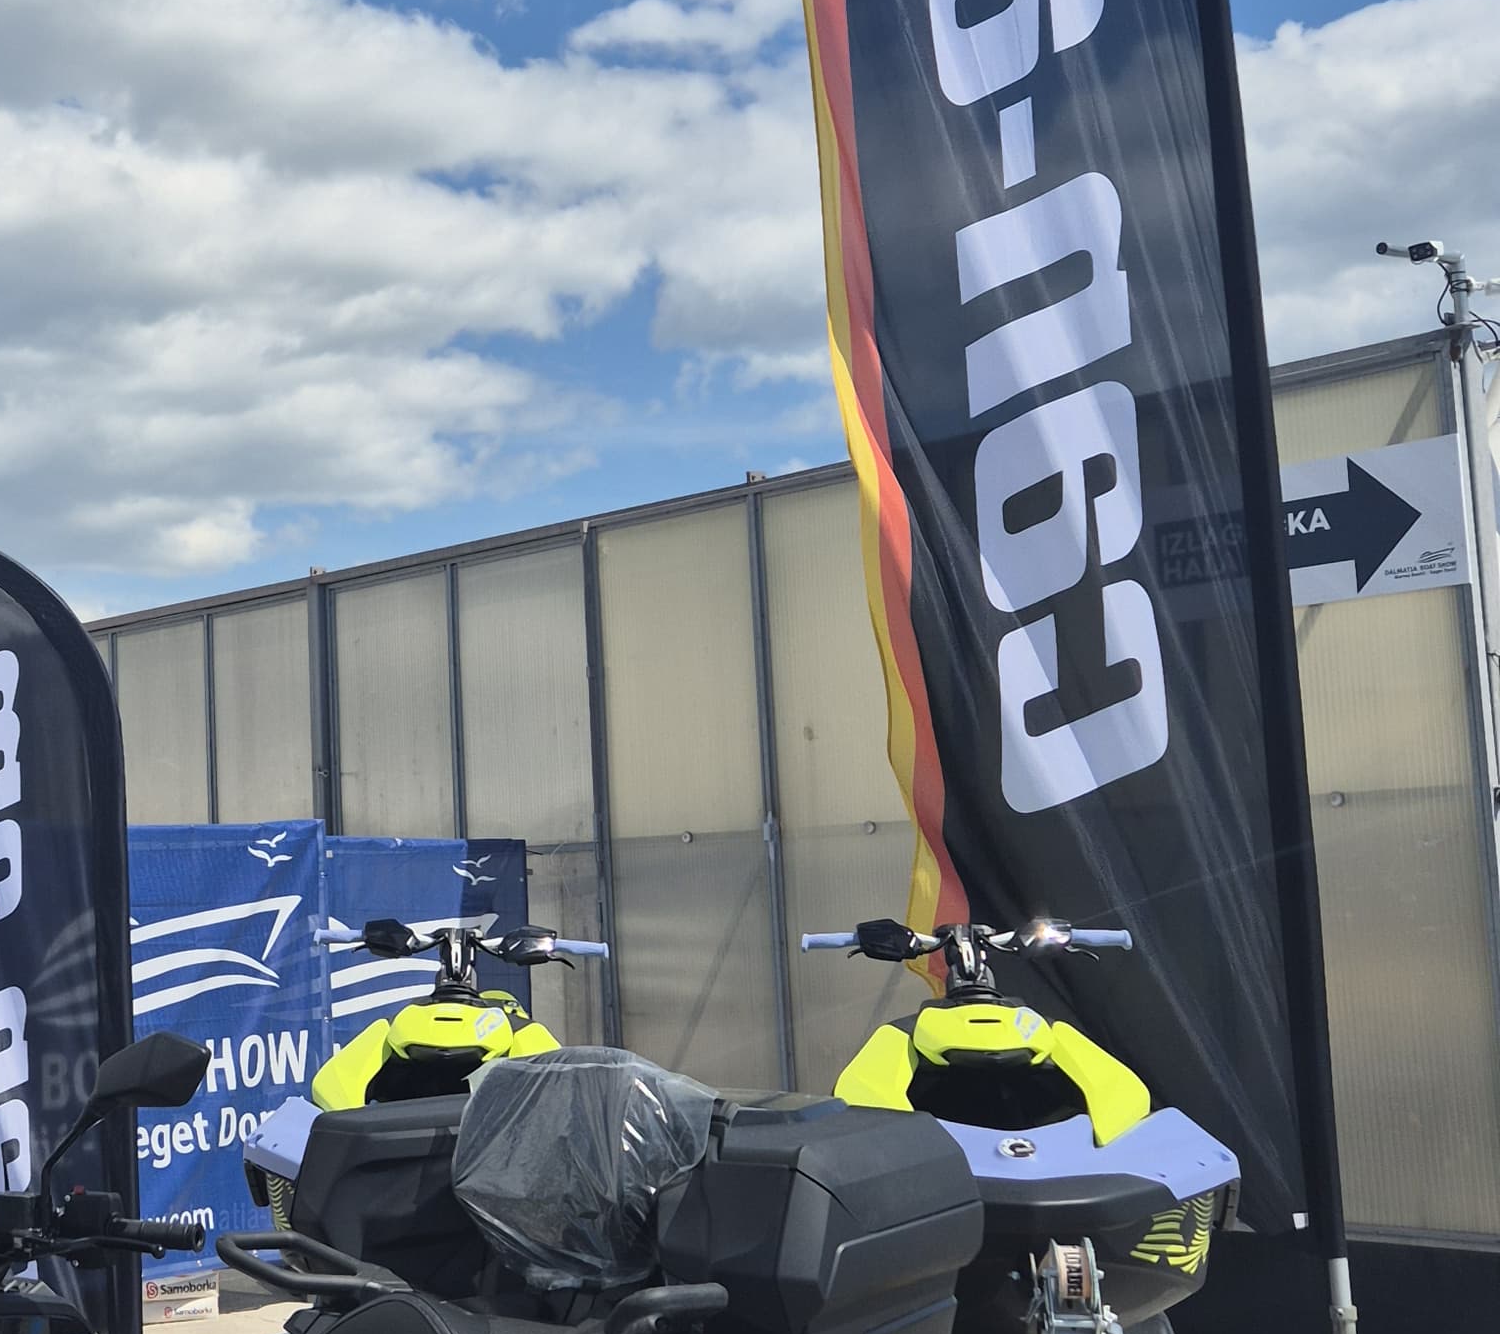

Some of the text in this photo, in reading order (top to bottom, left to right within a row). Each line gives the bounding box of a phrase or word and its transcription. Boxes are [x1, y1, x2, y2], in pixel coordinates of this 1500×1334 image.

[205, 1030, 309, 1093] HOW
[136, 1111, 211, 1169] eget
[159, 1279, 217, 1296] Samoborka
